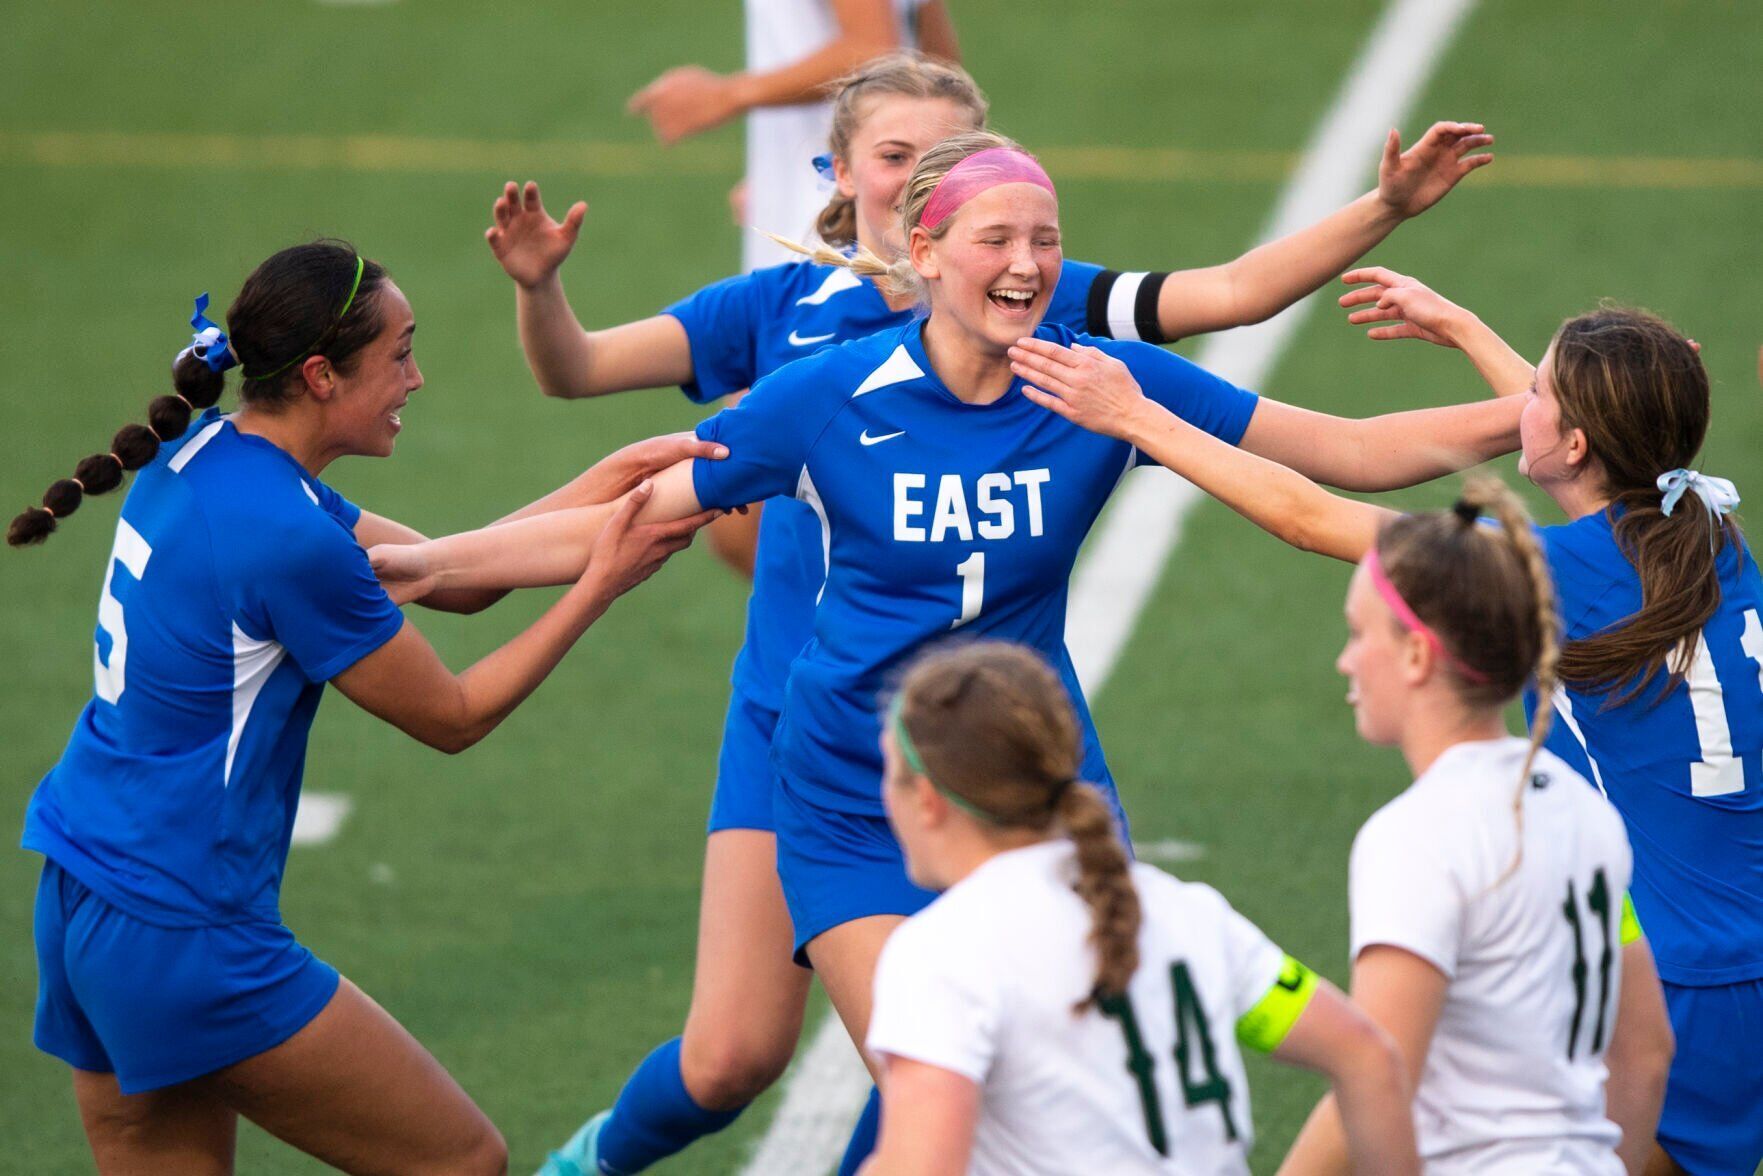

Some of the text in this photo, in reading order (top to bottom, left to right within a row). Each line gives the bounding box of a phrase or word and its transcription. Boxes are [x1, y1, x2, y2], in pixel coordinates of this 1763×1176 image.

[893, 468, 1050, 542] EAST
[950, 552, 985, 629] 1
[94, 516, 153, 706] 5
[1096, 958, 1238, 1157] 14
[1562, 867, 1613, 1063] 11
